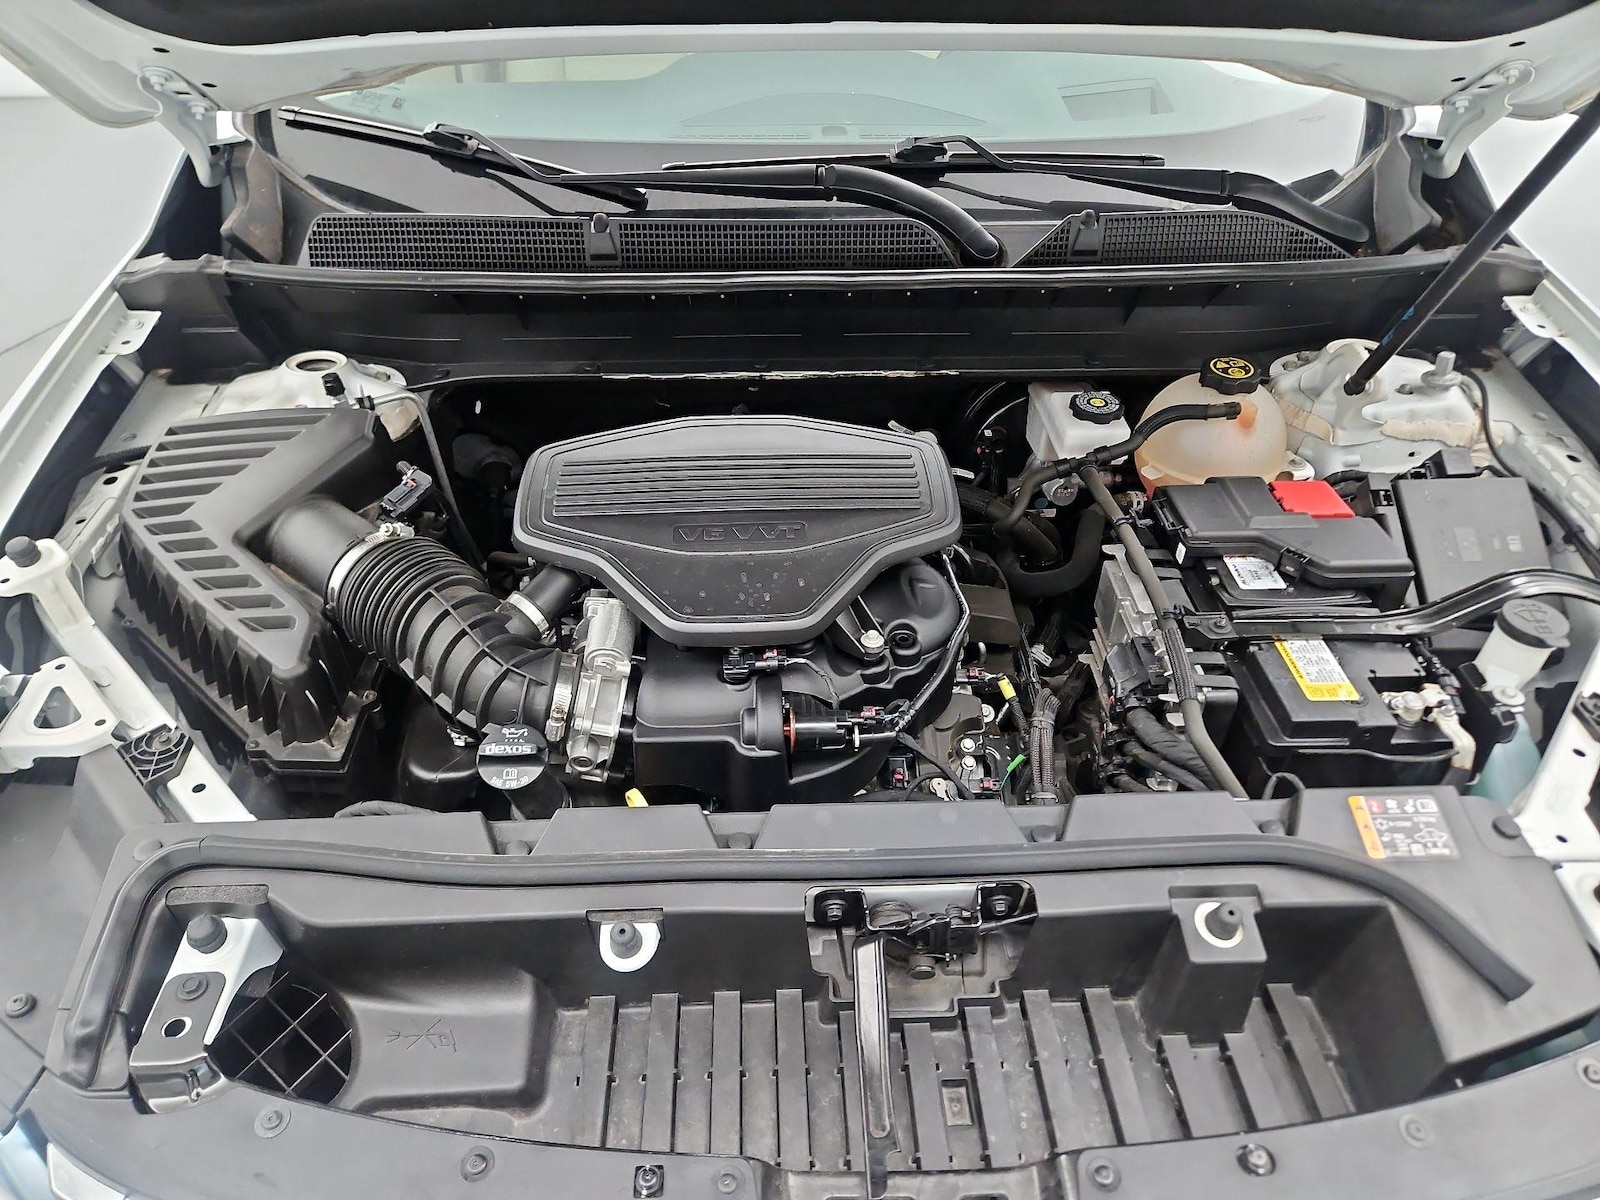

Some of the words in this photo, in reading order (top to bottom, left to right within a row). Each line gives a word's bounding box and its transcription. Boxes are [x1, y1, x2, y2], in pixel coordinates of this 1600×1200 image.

[678, 527, 725, 541] V6
[731, 525, 801, 539] VVT
[485, 743, 532, 754] dexos
[490, 776, 504, 787] SAE
[505, 775, 529, 788] 5W-30
